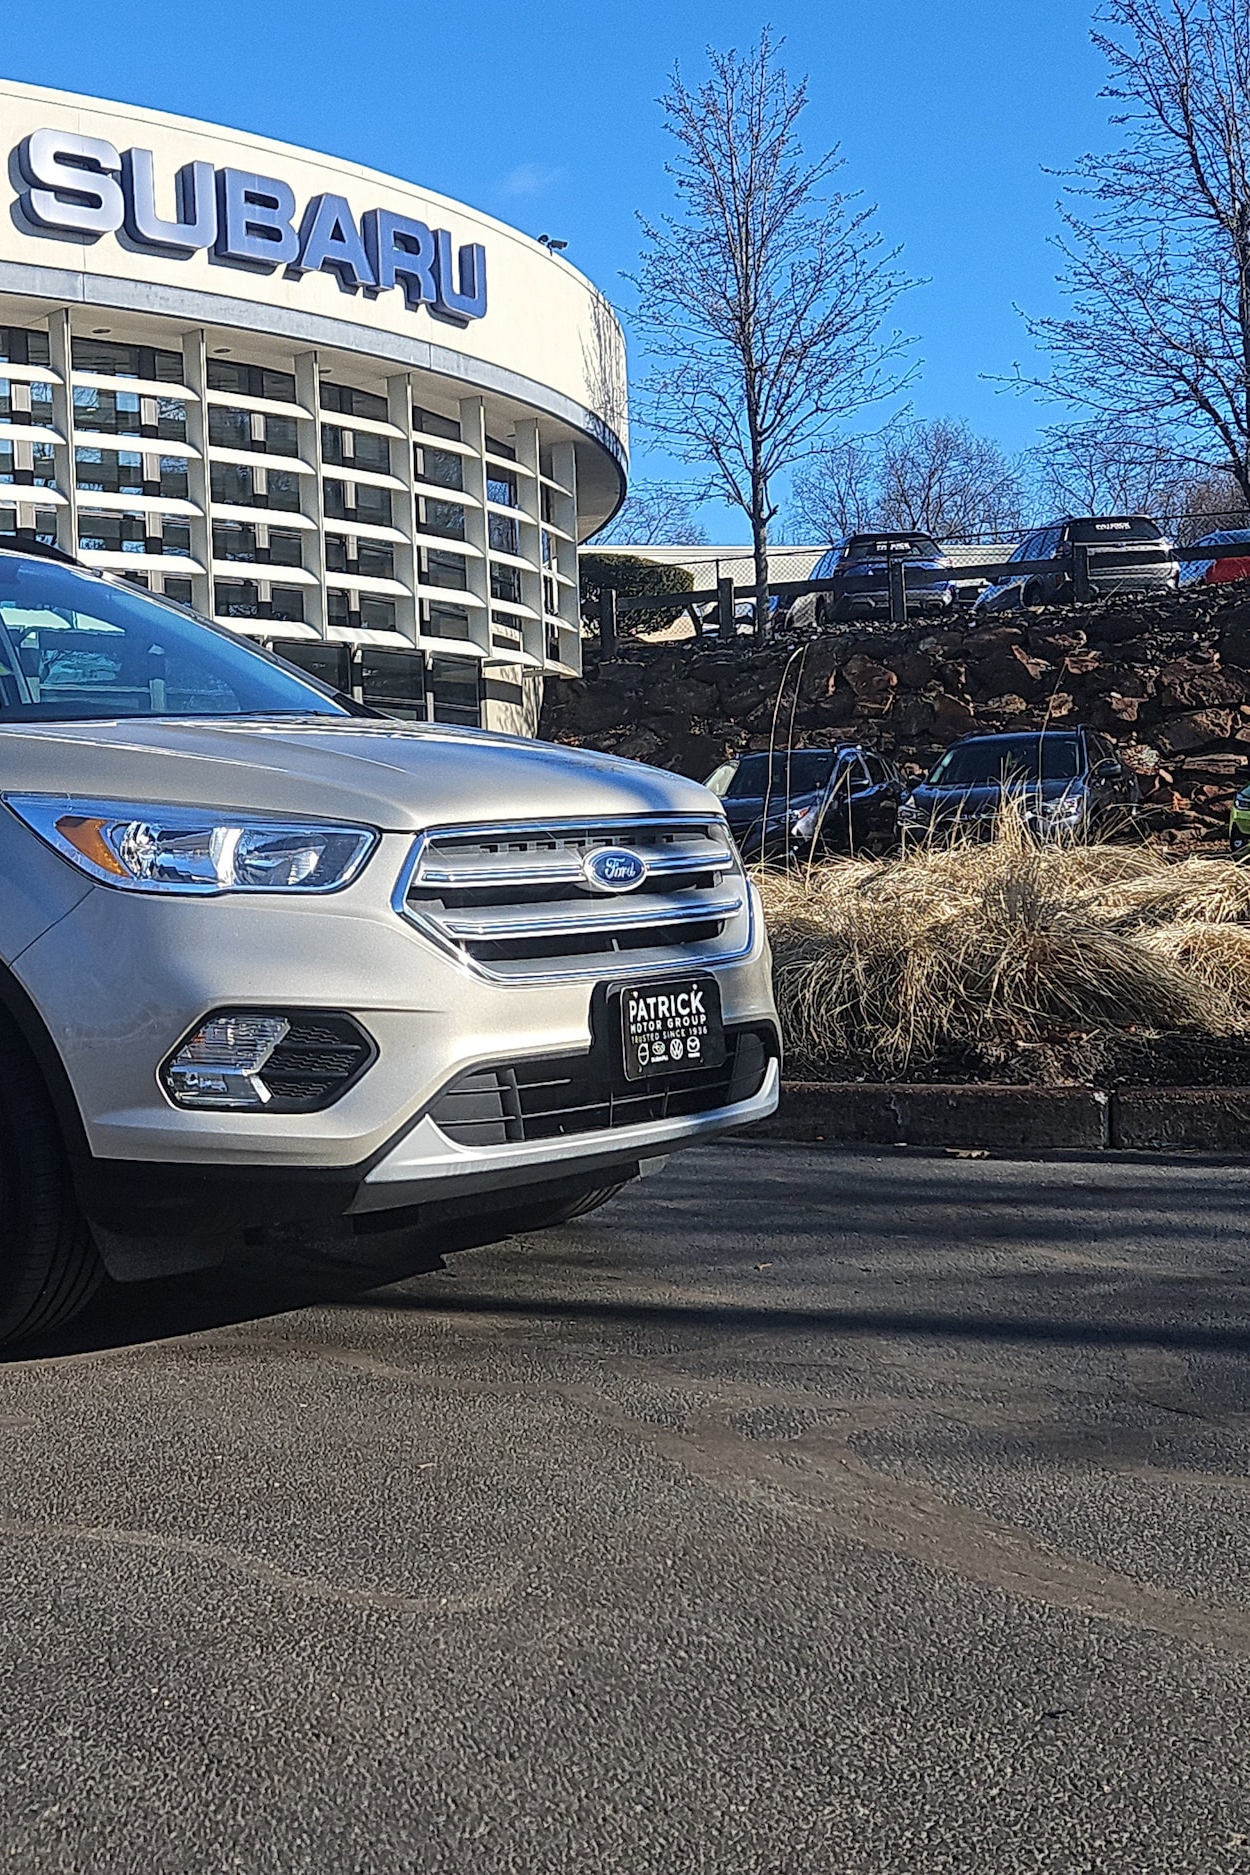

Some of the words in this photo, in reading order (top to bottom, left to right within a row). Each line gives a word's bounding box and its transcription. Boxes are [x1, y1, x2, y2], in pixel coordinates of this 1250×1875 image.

[16, 126, 488, 322] SUBARU
[604, 857, 636, 879] Ford
[628, 991, 706, 1023] PATRICK
[630, 1020, 662, 1035] MOTOR
[667, 1014, 707, 1028] GROUP
[631, 1032, 660, 1045] TRUSTED
[663, 1027, 686, 1040] SINCE
